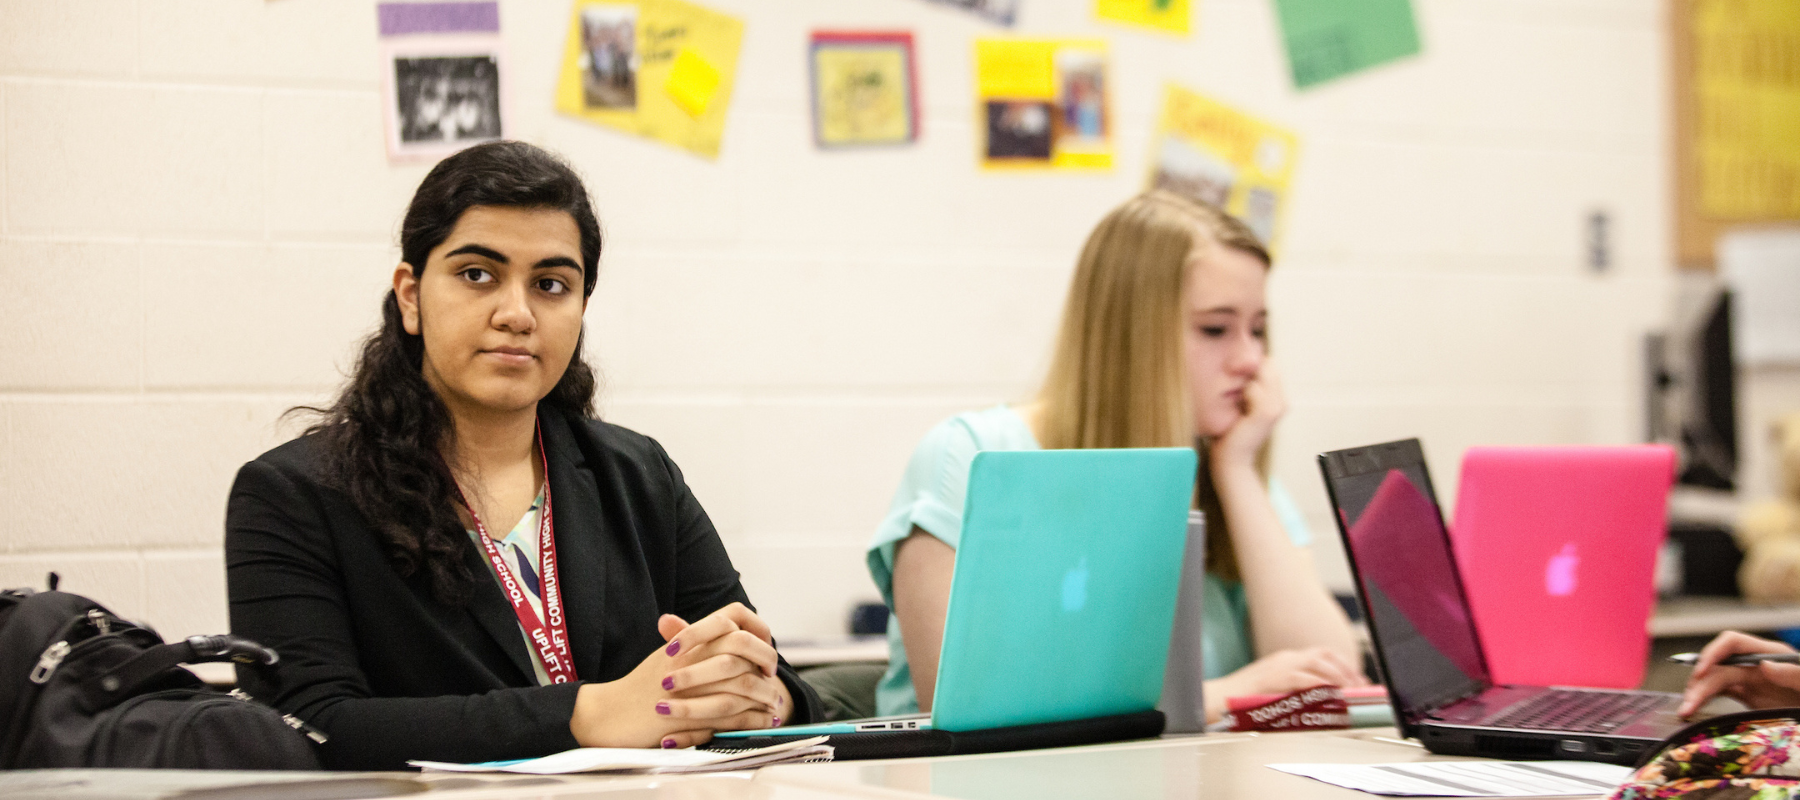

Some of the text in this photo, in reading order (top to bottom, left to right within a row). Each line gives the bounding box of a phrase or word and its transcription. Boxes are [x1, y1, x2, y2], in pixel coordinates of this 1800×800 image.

[542, 517, 552, 549] HIGH
[492, 555, 524, 609] SCHOOL
[543, 550, 562, 627] COMMUNITY
[532, 627, 562, 674] UPLIFT
